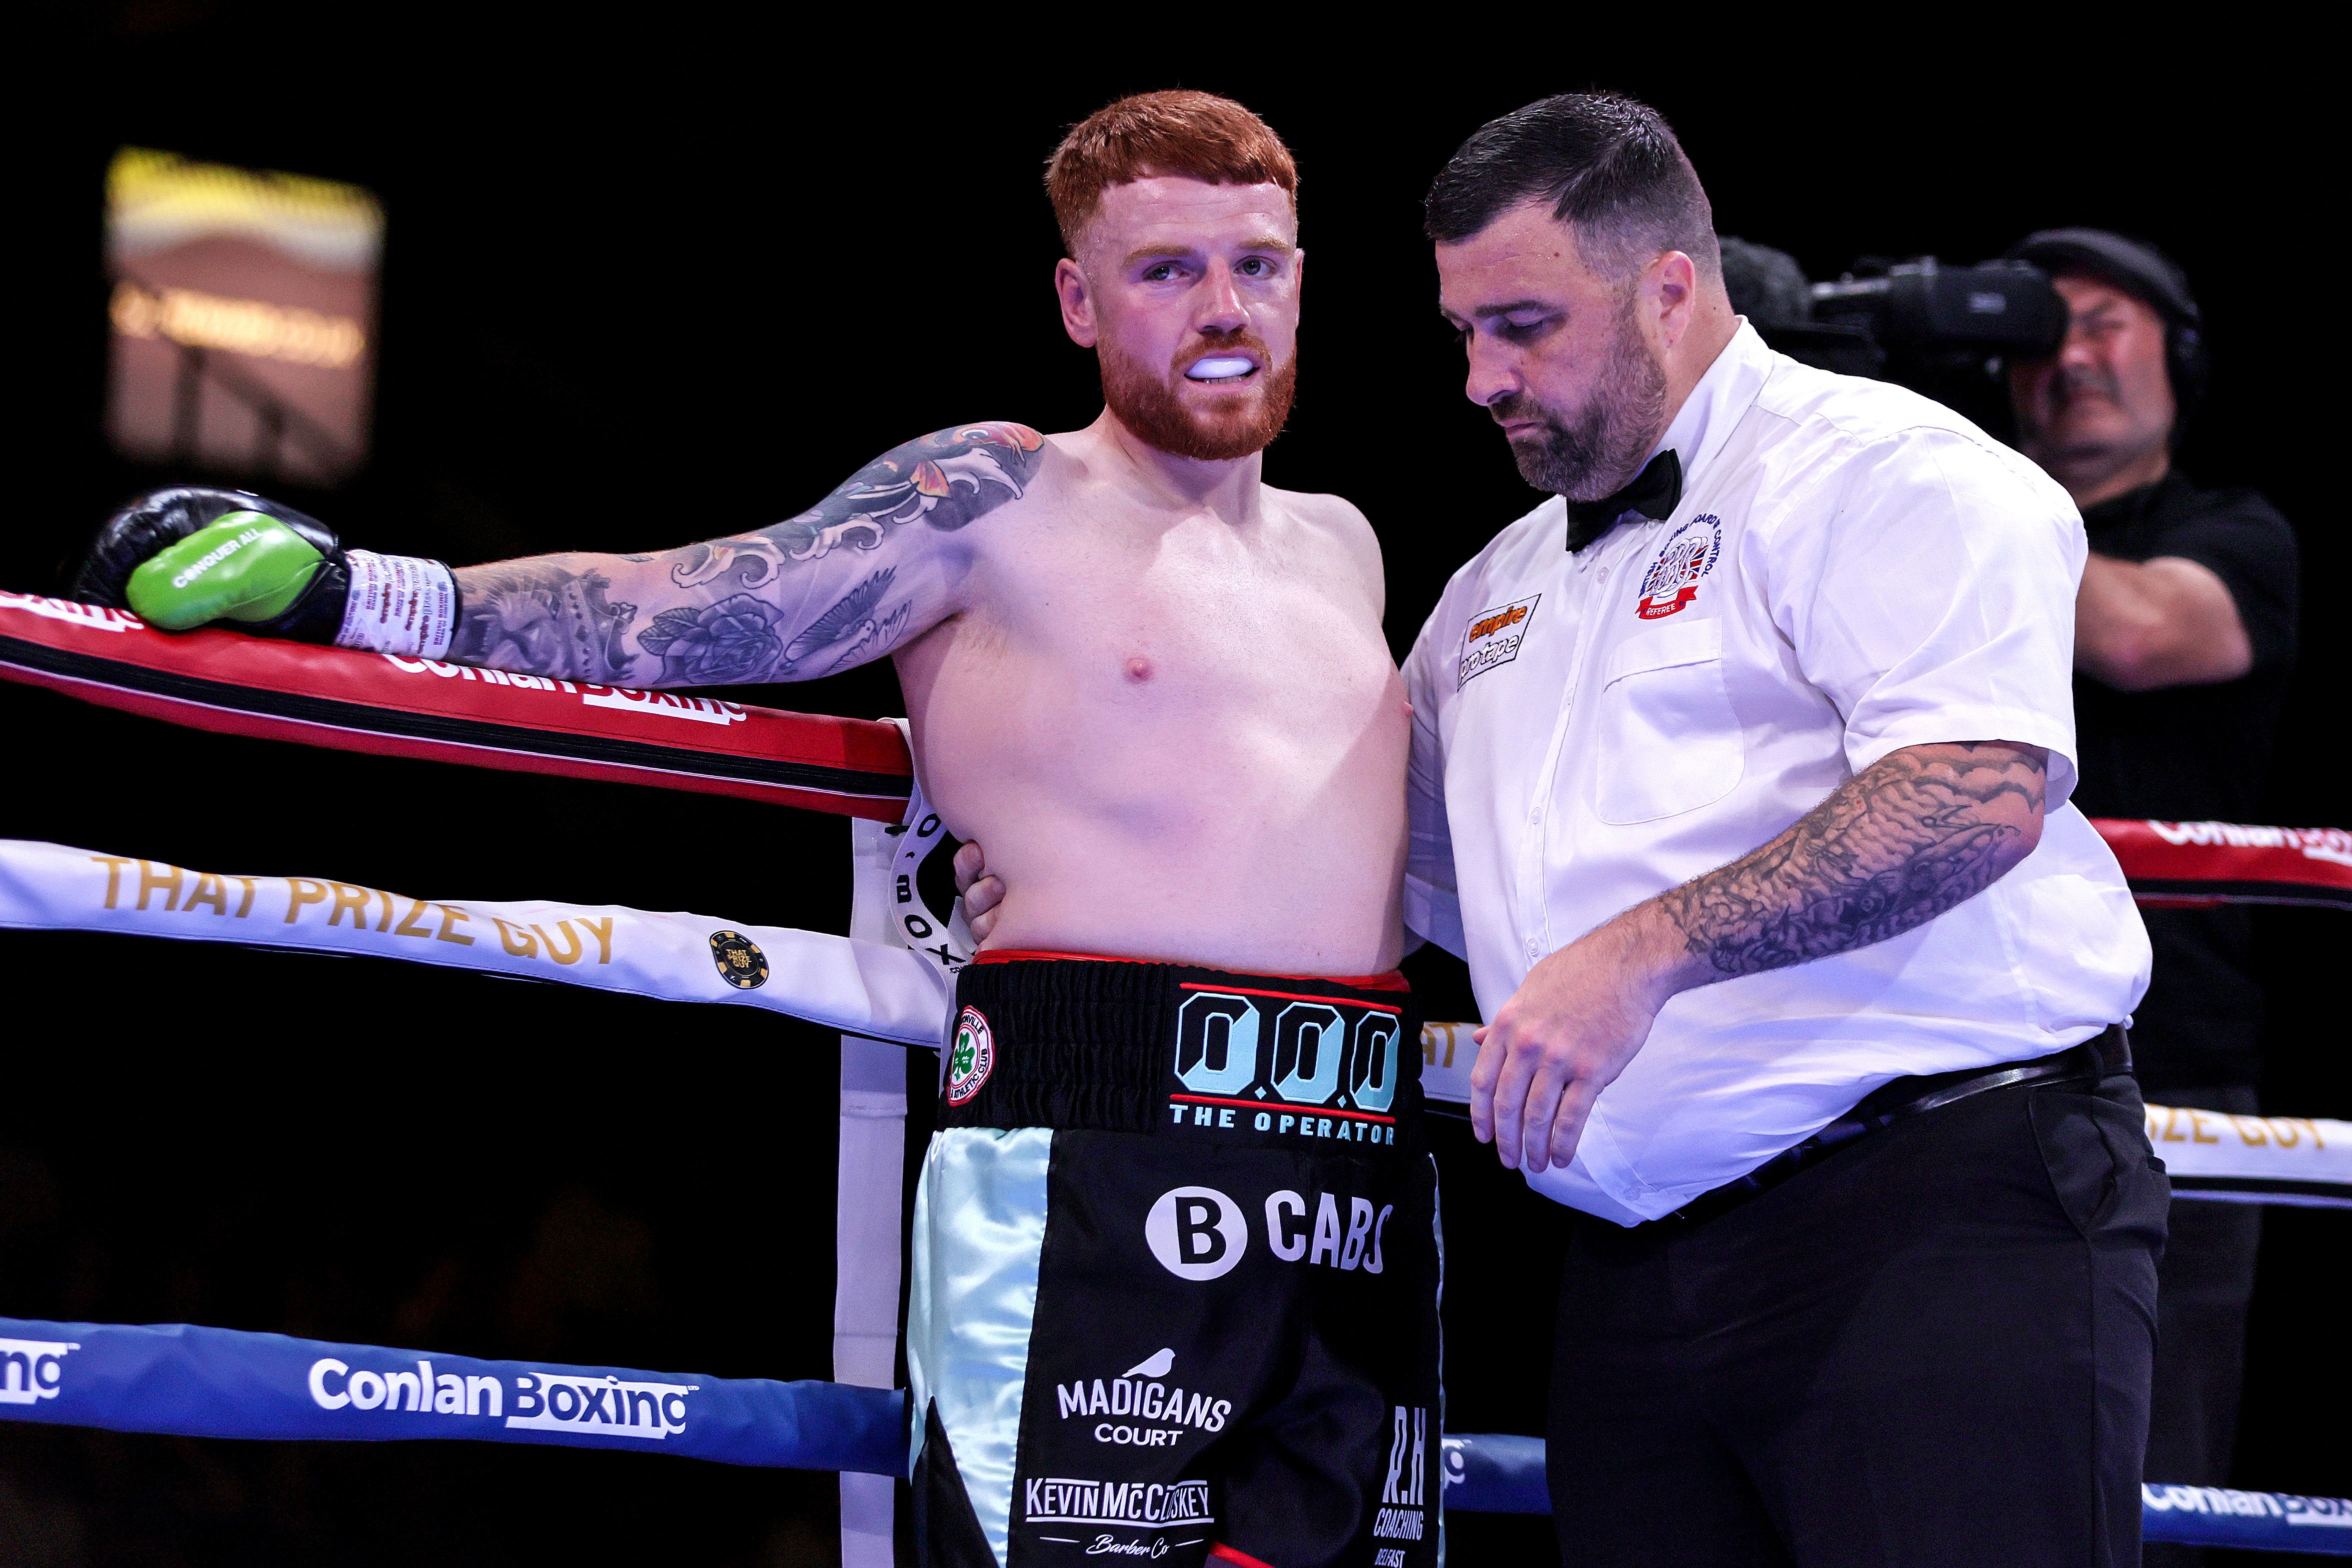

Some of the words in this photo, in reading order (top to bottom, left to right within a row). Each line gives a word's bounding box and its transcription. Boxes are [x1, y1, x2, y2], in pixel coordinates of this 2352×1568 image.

[172, 539, 242, 588] CONQUER
[238, 528, 262, 545] ALL
[1701, 529, 1721, 577] CONTROL
[1646, 603, 1676, 616] REFEREE
[91, 855, 262, 919] THAT
[283, 877, 476, 946] PRIZE
[491, 916, 614, 965] GUY
[978, 1048, 988, 1074] CLUB
[1169, 1104, 1236, 1128] THE
[1254, 1113, 1394, 1146] OPERATOR
[1175, 1196, 1227, 1265] B
[1265, 1190, 1393, 1274] CABS
[308, 1358, 503, 1417] Conlan
[507, 1372, 687, 1439] Boxing
[1057, 1379, 1232, 1432] MADIGANS
[1094, 1423, 1183, 1446] COURT
[1382, 1406, 1426, 1506] R.H
[1085, 1535, 1151, 1555] Barber
[1151, 1537, 1170, 1559] Co
[1373, 1508, 1424, 1541] COACHING
[1374, 1548, 1406, 1568] BELFAST
